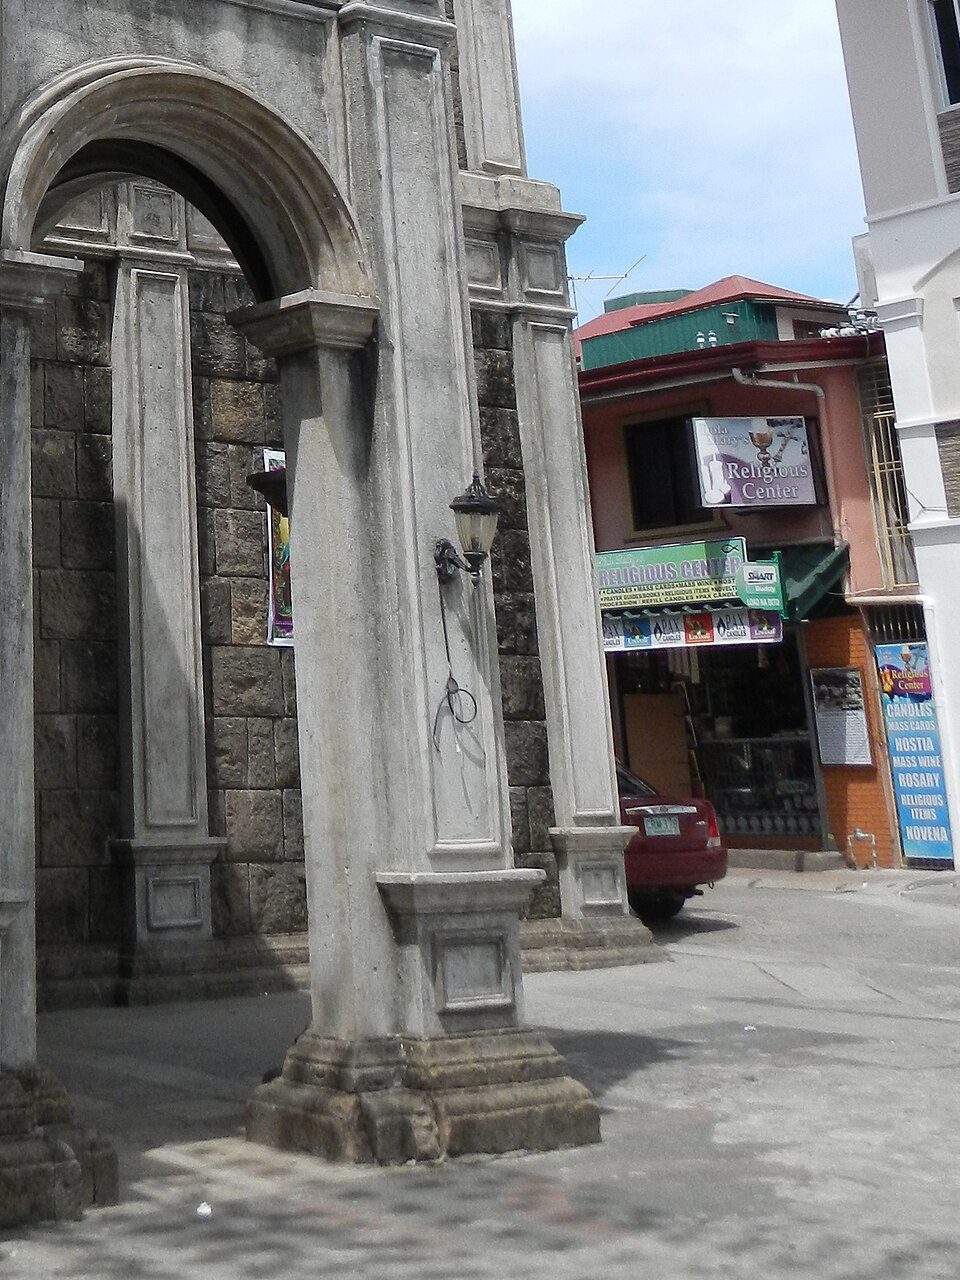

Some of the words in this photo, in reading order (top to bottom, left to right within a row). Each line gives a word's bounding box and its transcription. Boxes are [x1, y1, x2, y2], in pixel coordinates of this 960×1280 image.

[726, 462, 808, 483] Religious
[742, 482, 799, 500] Center
[597, 561, 678, 587] RELIGIOUS
[681, 555, 741, 580] CENTER
[748, 572, 774, 581] SMART
[604, 594, 624, 602] PRAYER
[606, 587, 632, 595] CANDLES
[662, 618, 681, 635] PAX
[725, 612, 746, 630] PAX
[891, 669, 928, 681] Religious
[898, 681, 924, 690] Center
[886, 702, 933, 717] CANDLES
[888, 720, 909, 731] MASS
[910, 719, 936, 731] CARDS
[895, 736, 935, 752] HOSTIA
[893, 756, 917, 768] MASS
[918, 755, 942, 768] WINE
[898, 772, 940, 788] ROSARY
[900, 793, 944, 807] RELIGIOUS
[911, 808, 937, 820] ITEMS
[905, 825, 948, 841] NOVENA
